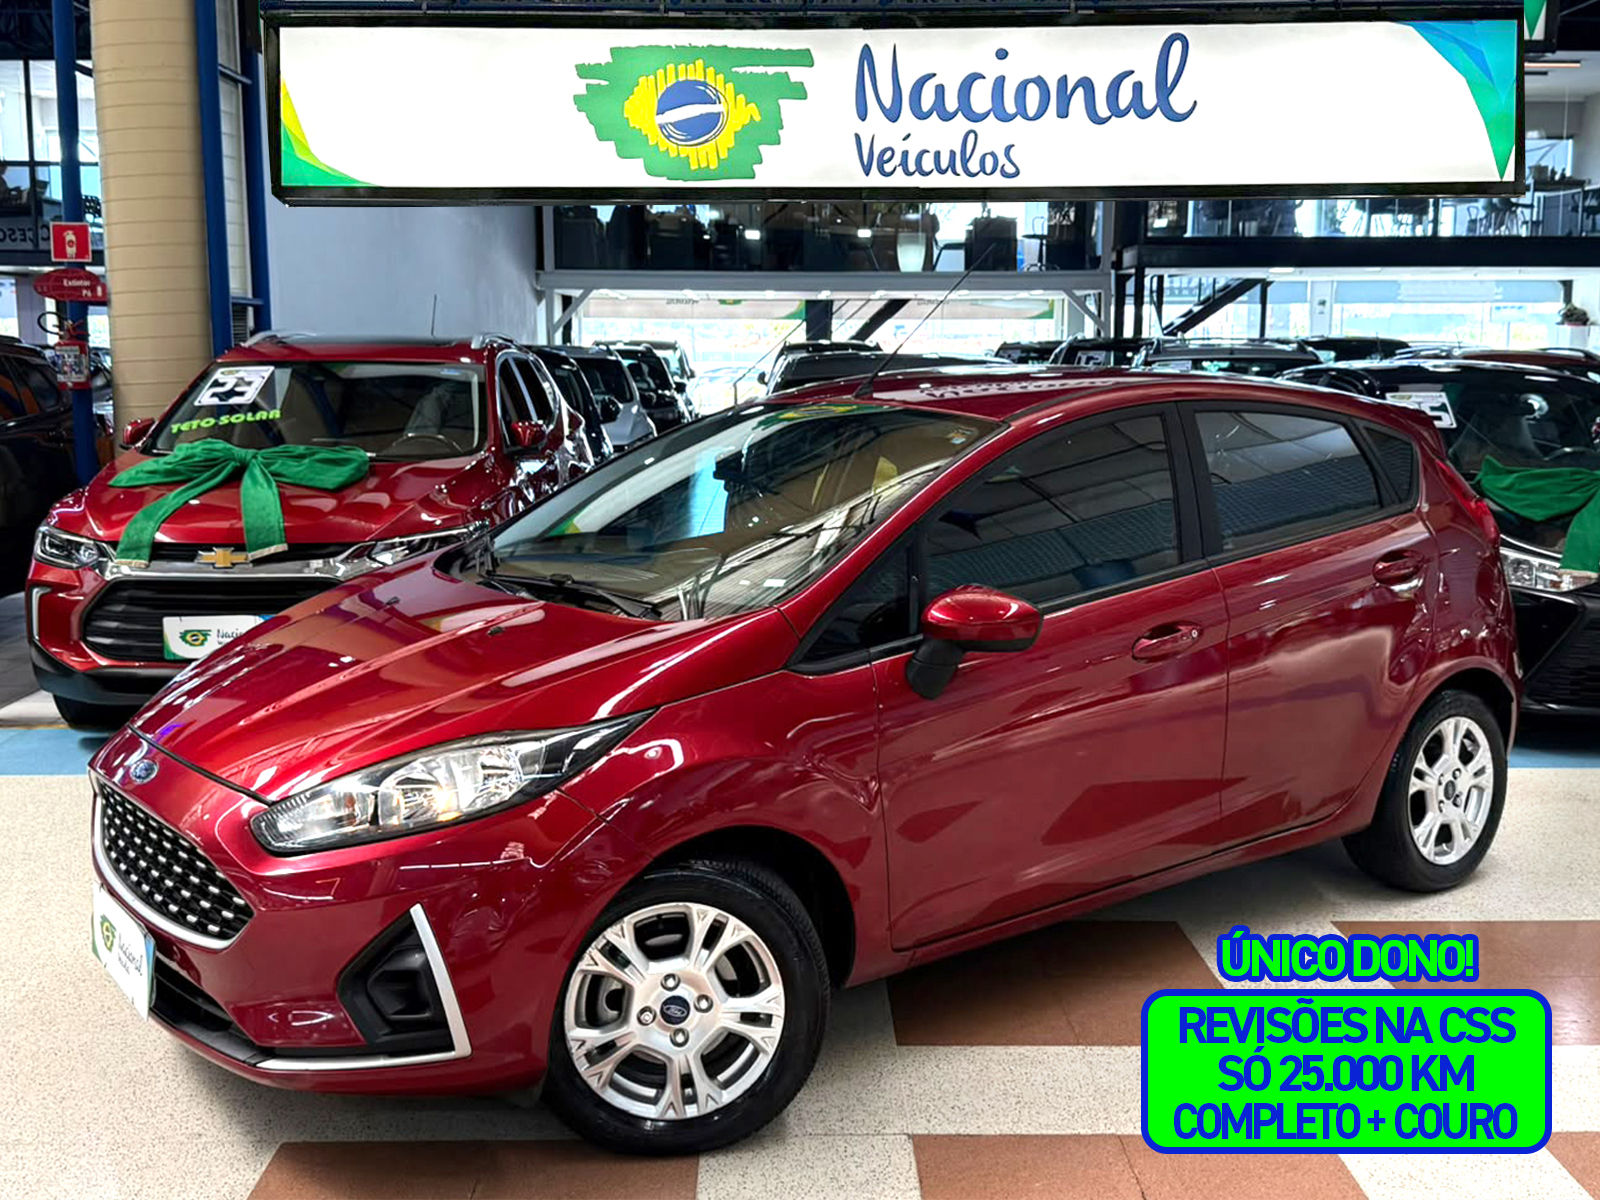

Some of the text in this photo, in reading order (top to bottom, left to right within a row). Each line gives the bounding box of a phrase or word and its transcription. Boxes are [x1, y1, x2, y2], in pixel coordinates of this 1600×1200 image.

[855, 32, 1198, 126] Nacional
[855, 129, 1020, 178] Veículos
[171, 409, 282, 434] TETO SOLAR
